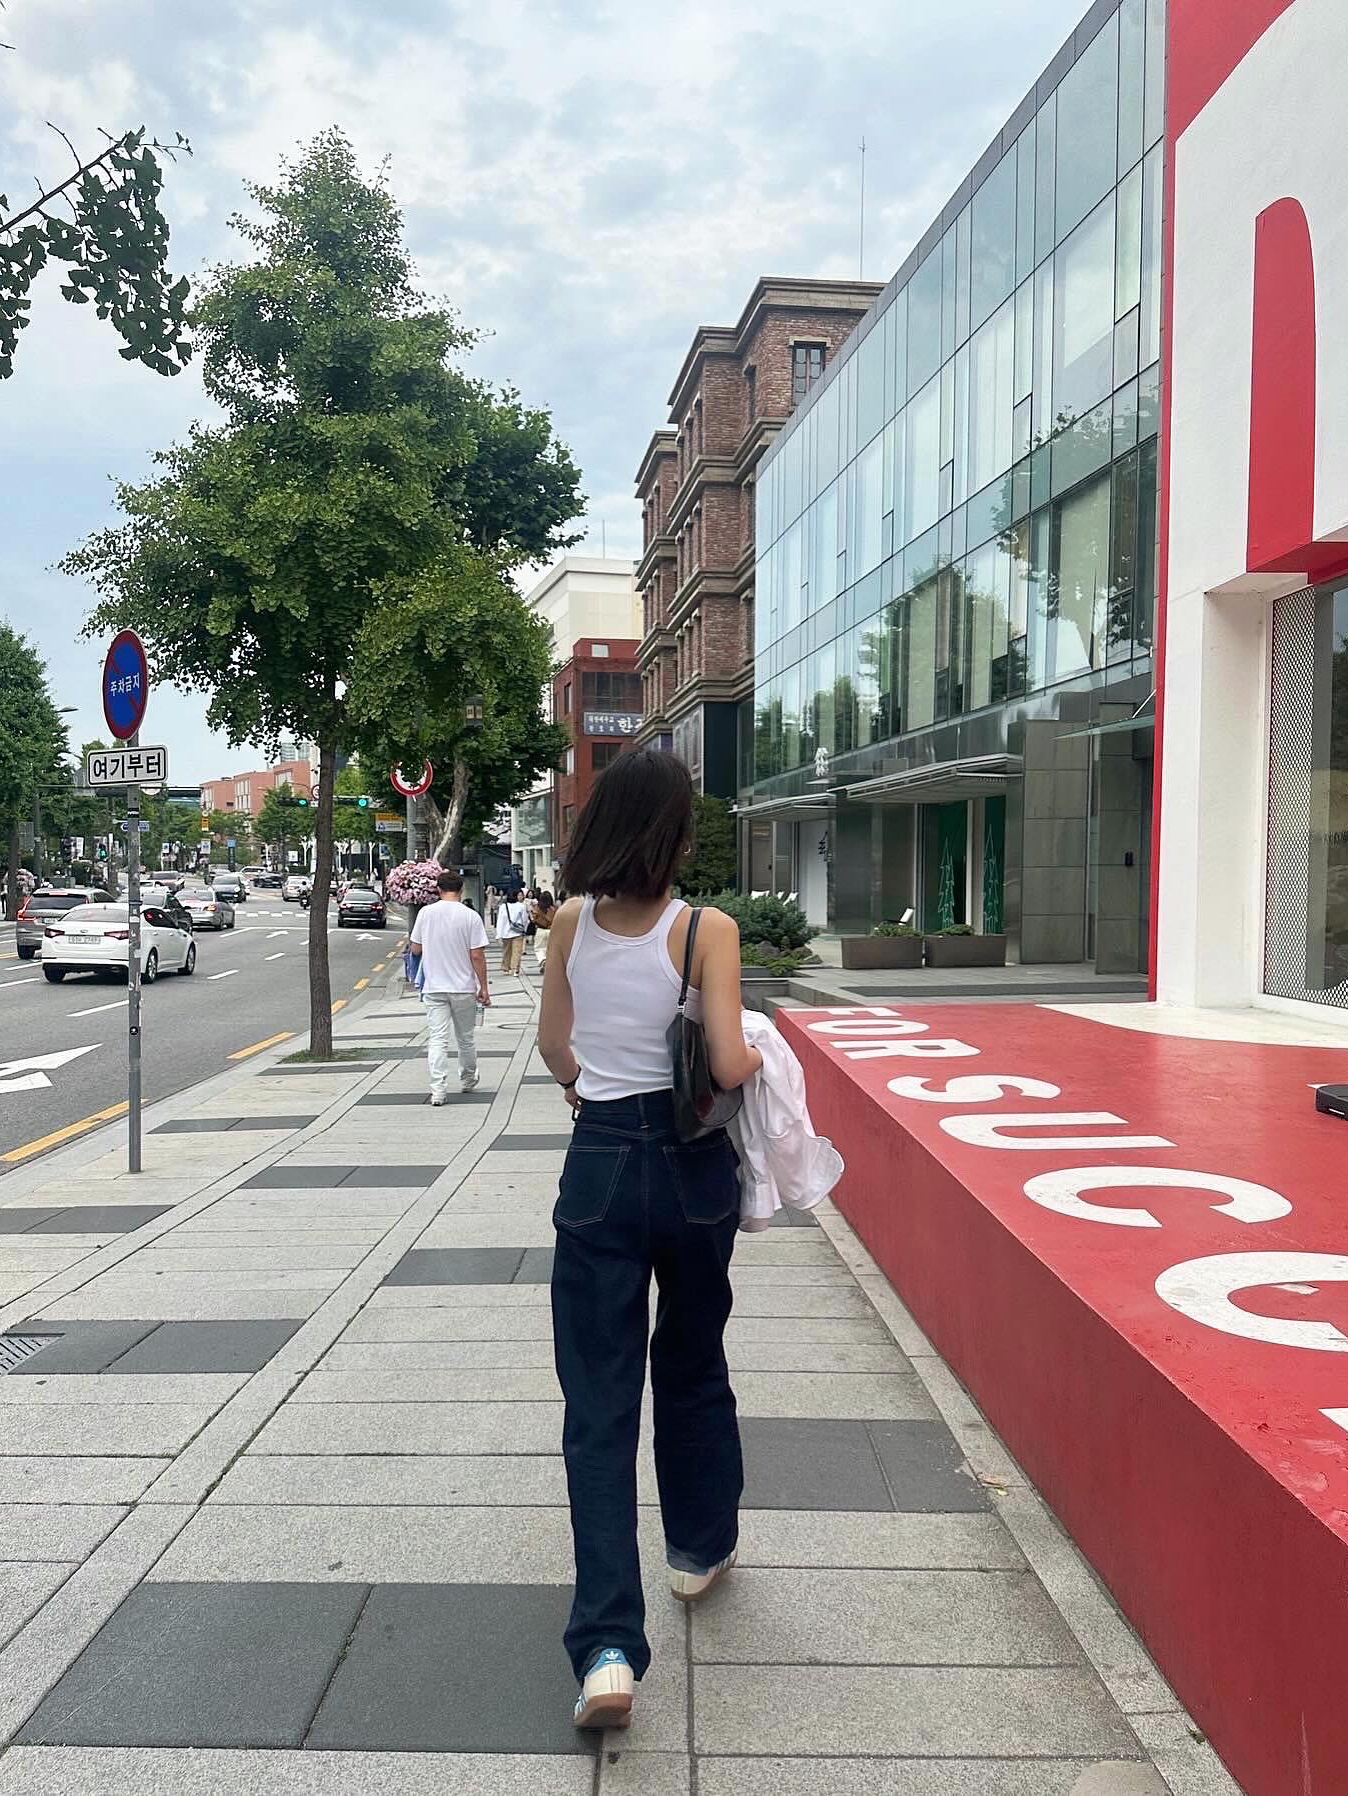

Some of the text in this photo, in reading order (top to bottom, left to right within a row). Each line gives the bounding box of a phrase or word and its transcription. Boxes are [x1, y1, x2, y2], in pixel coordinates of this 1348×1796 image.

[110, 673, 140, 696] 주차금지
[93, 752, 161, 779] 여기부터
[786, 1007, 982, 1060] FOR
